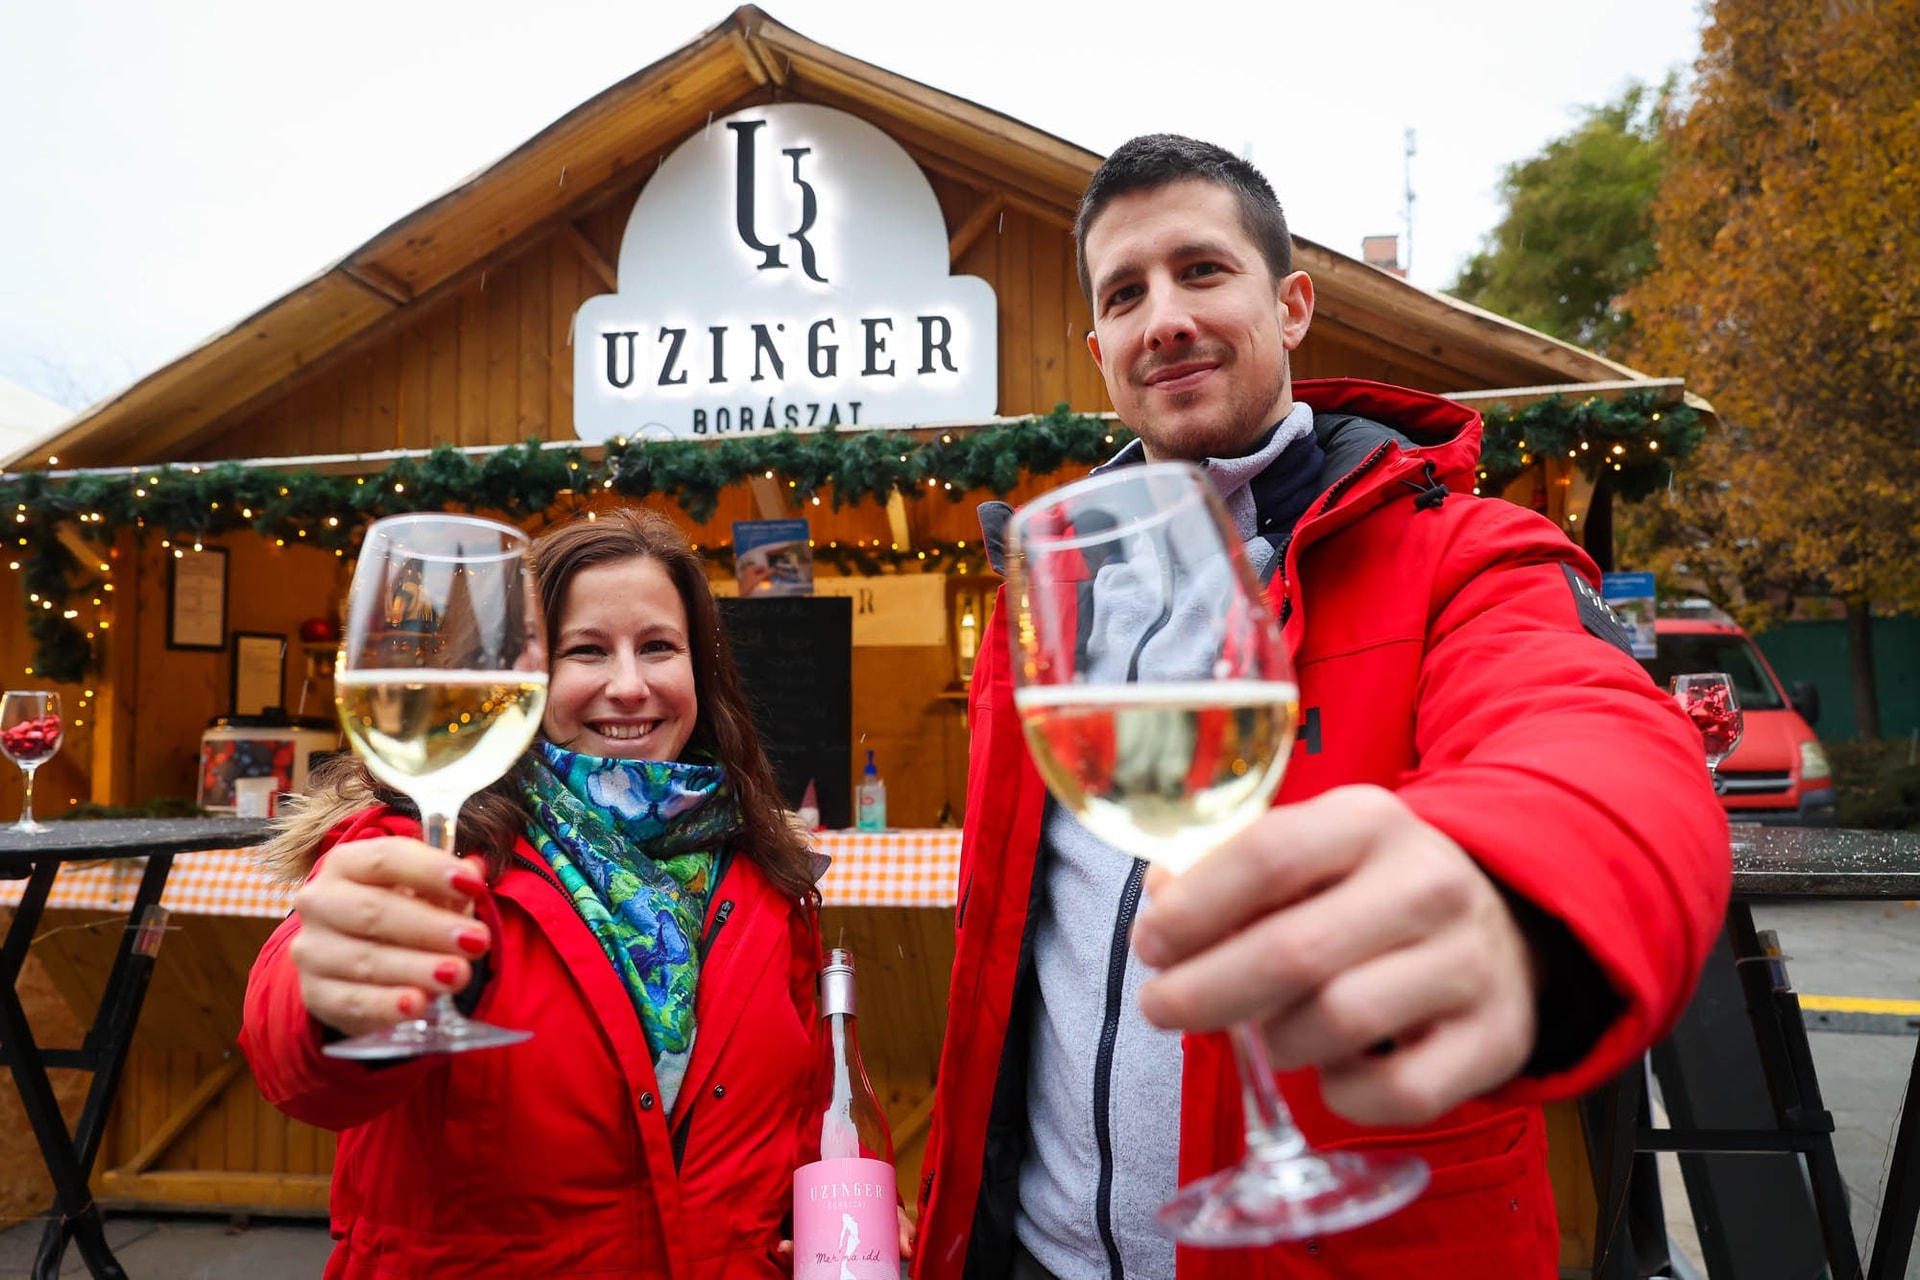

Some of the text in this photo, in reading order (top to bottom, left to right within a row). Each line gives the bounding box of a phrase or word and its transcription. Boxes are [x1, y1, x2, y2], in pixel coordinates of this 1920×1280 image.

[602, 315, 958, 388] UZINGER
[693, 396, 862, 434] BORÁSZAT
[809, 1182, 883, 1201] UZINGER
